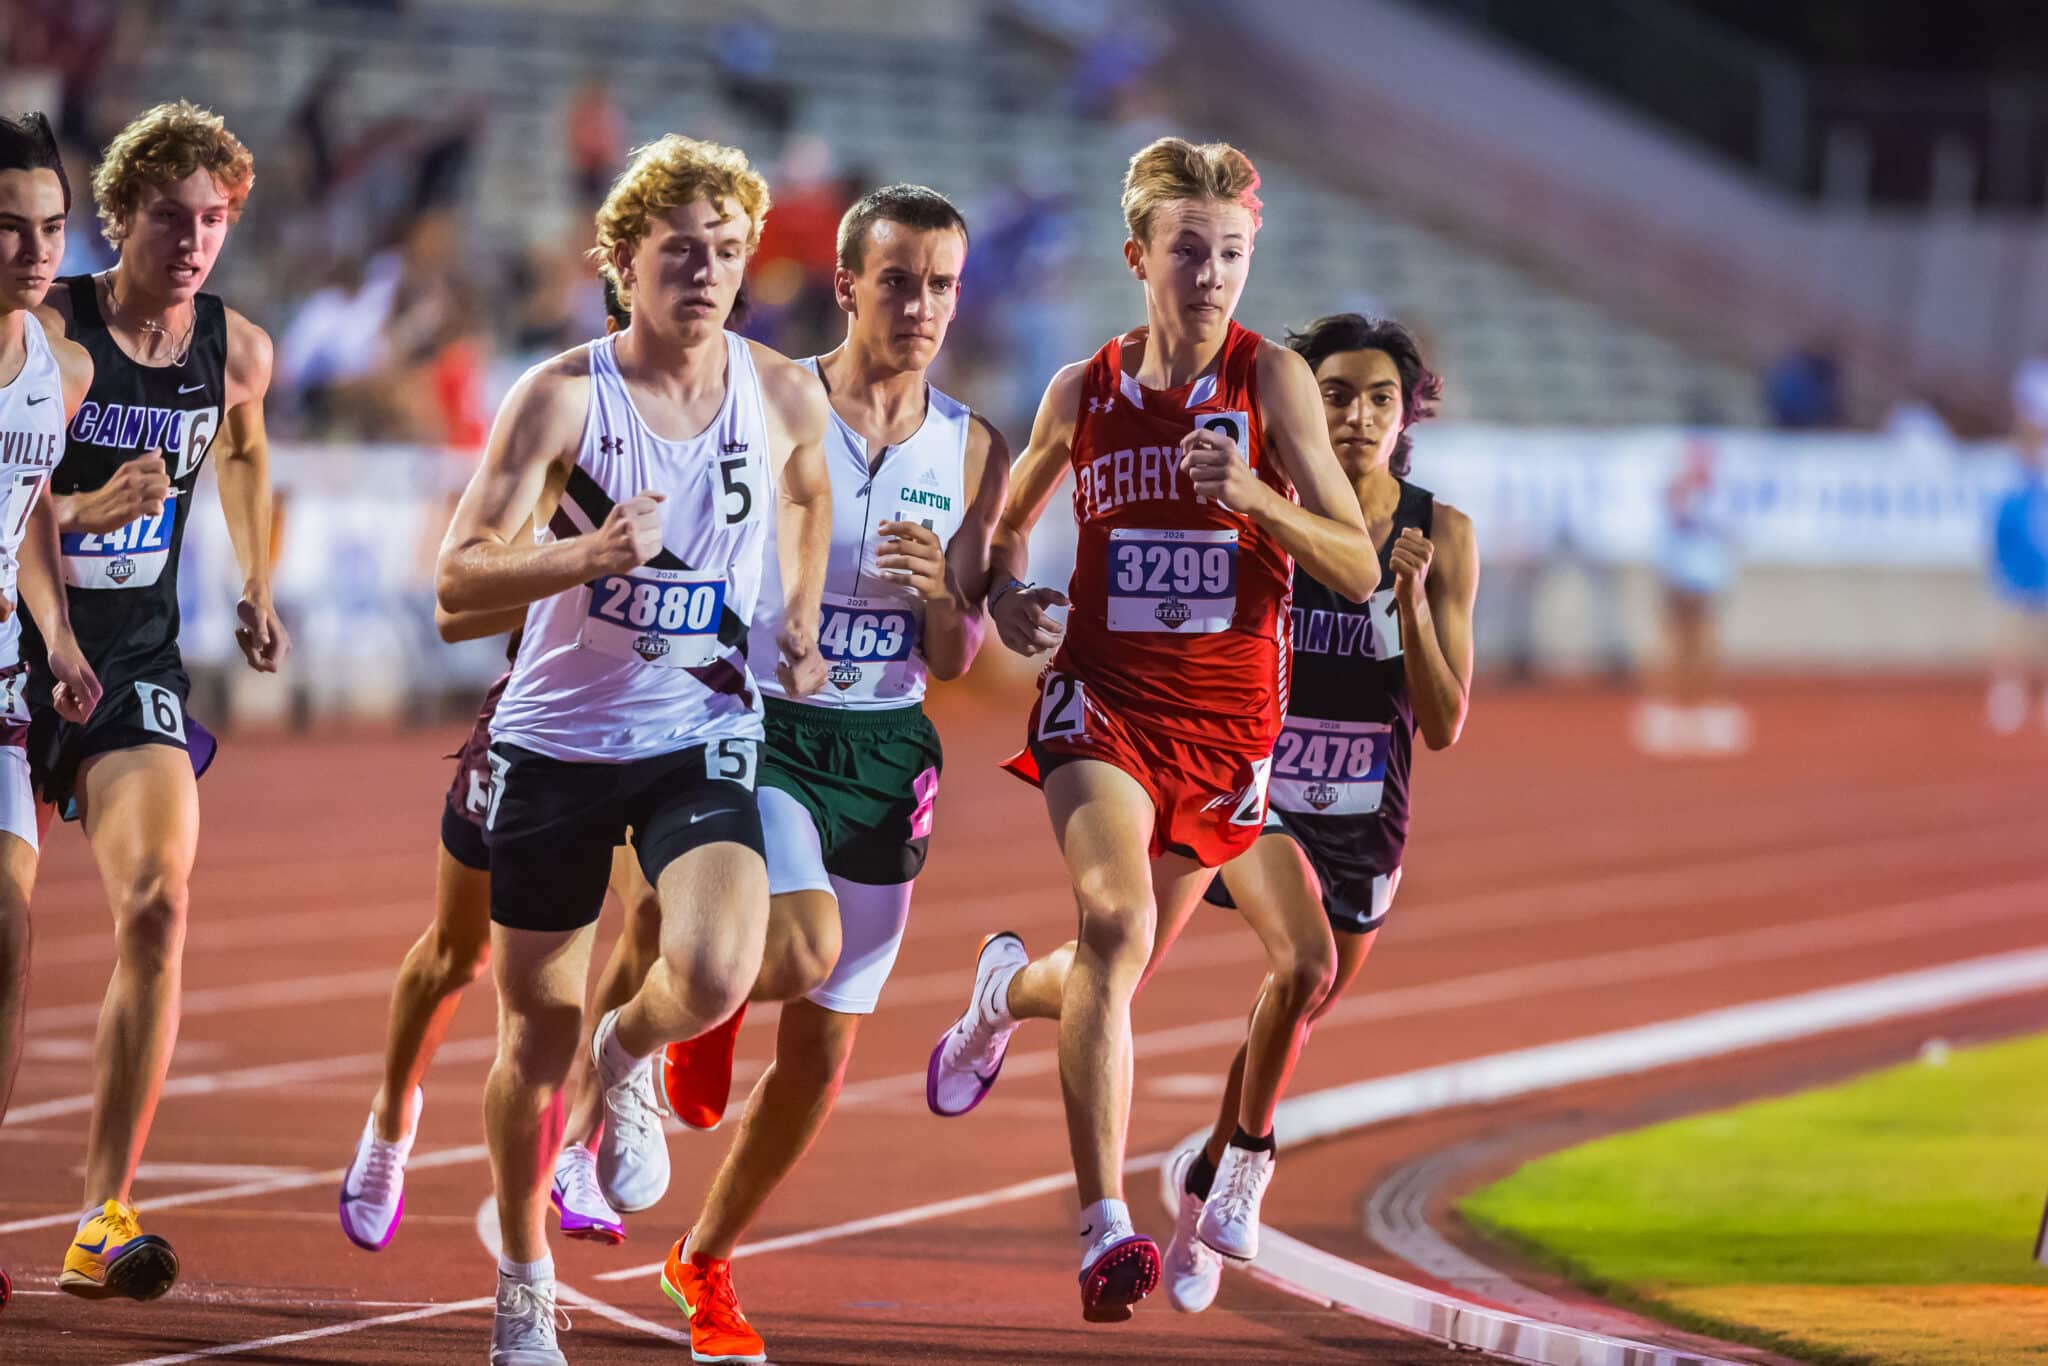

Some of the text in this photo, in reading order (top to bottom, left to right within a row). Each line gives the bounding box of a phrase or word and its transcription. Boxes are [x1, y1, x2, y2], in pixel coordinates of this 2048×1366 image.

[0, 431, 56, 466] VILLE
[186, 412, 209, 471] 6
[14, 474, 42, 536] 7
[719, 457, 752, 524] 5
[900, 487, 951, 512] CANTON
[1164, 531, 1184, 539] 2026
[656, 571, 678, 580] 2026
[1117, 545, 1230, 594] 3299
[600, 577, 716, 630] 2880
[1155, 609, 1191, 618] STATE
[633, 640, 670, 655] STATE
[820, 611, 905, 658] 463
[151, 688, 178, 733] 6
[1043, 674, 1076, 736] 2
[718, 739, 747, 779] 5
[1275, 732, 1374, 779] 2478
